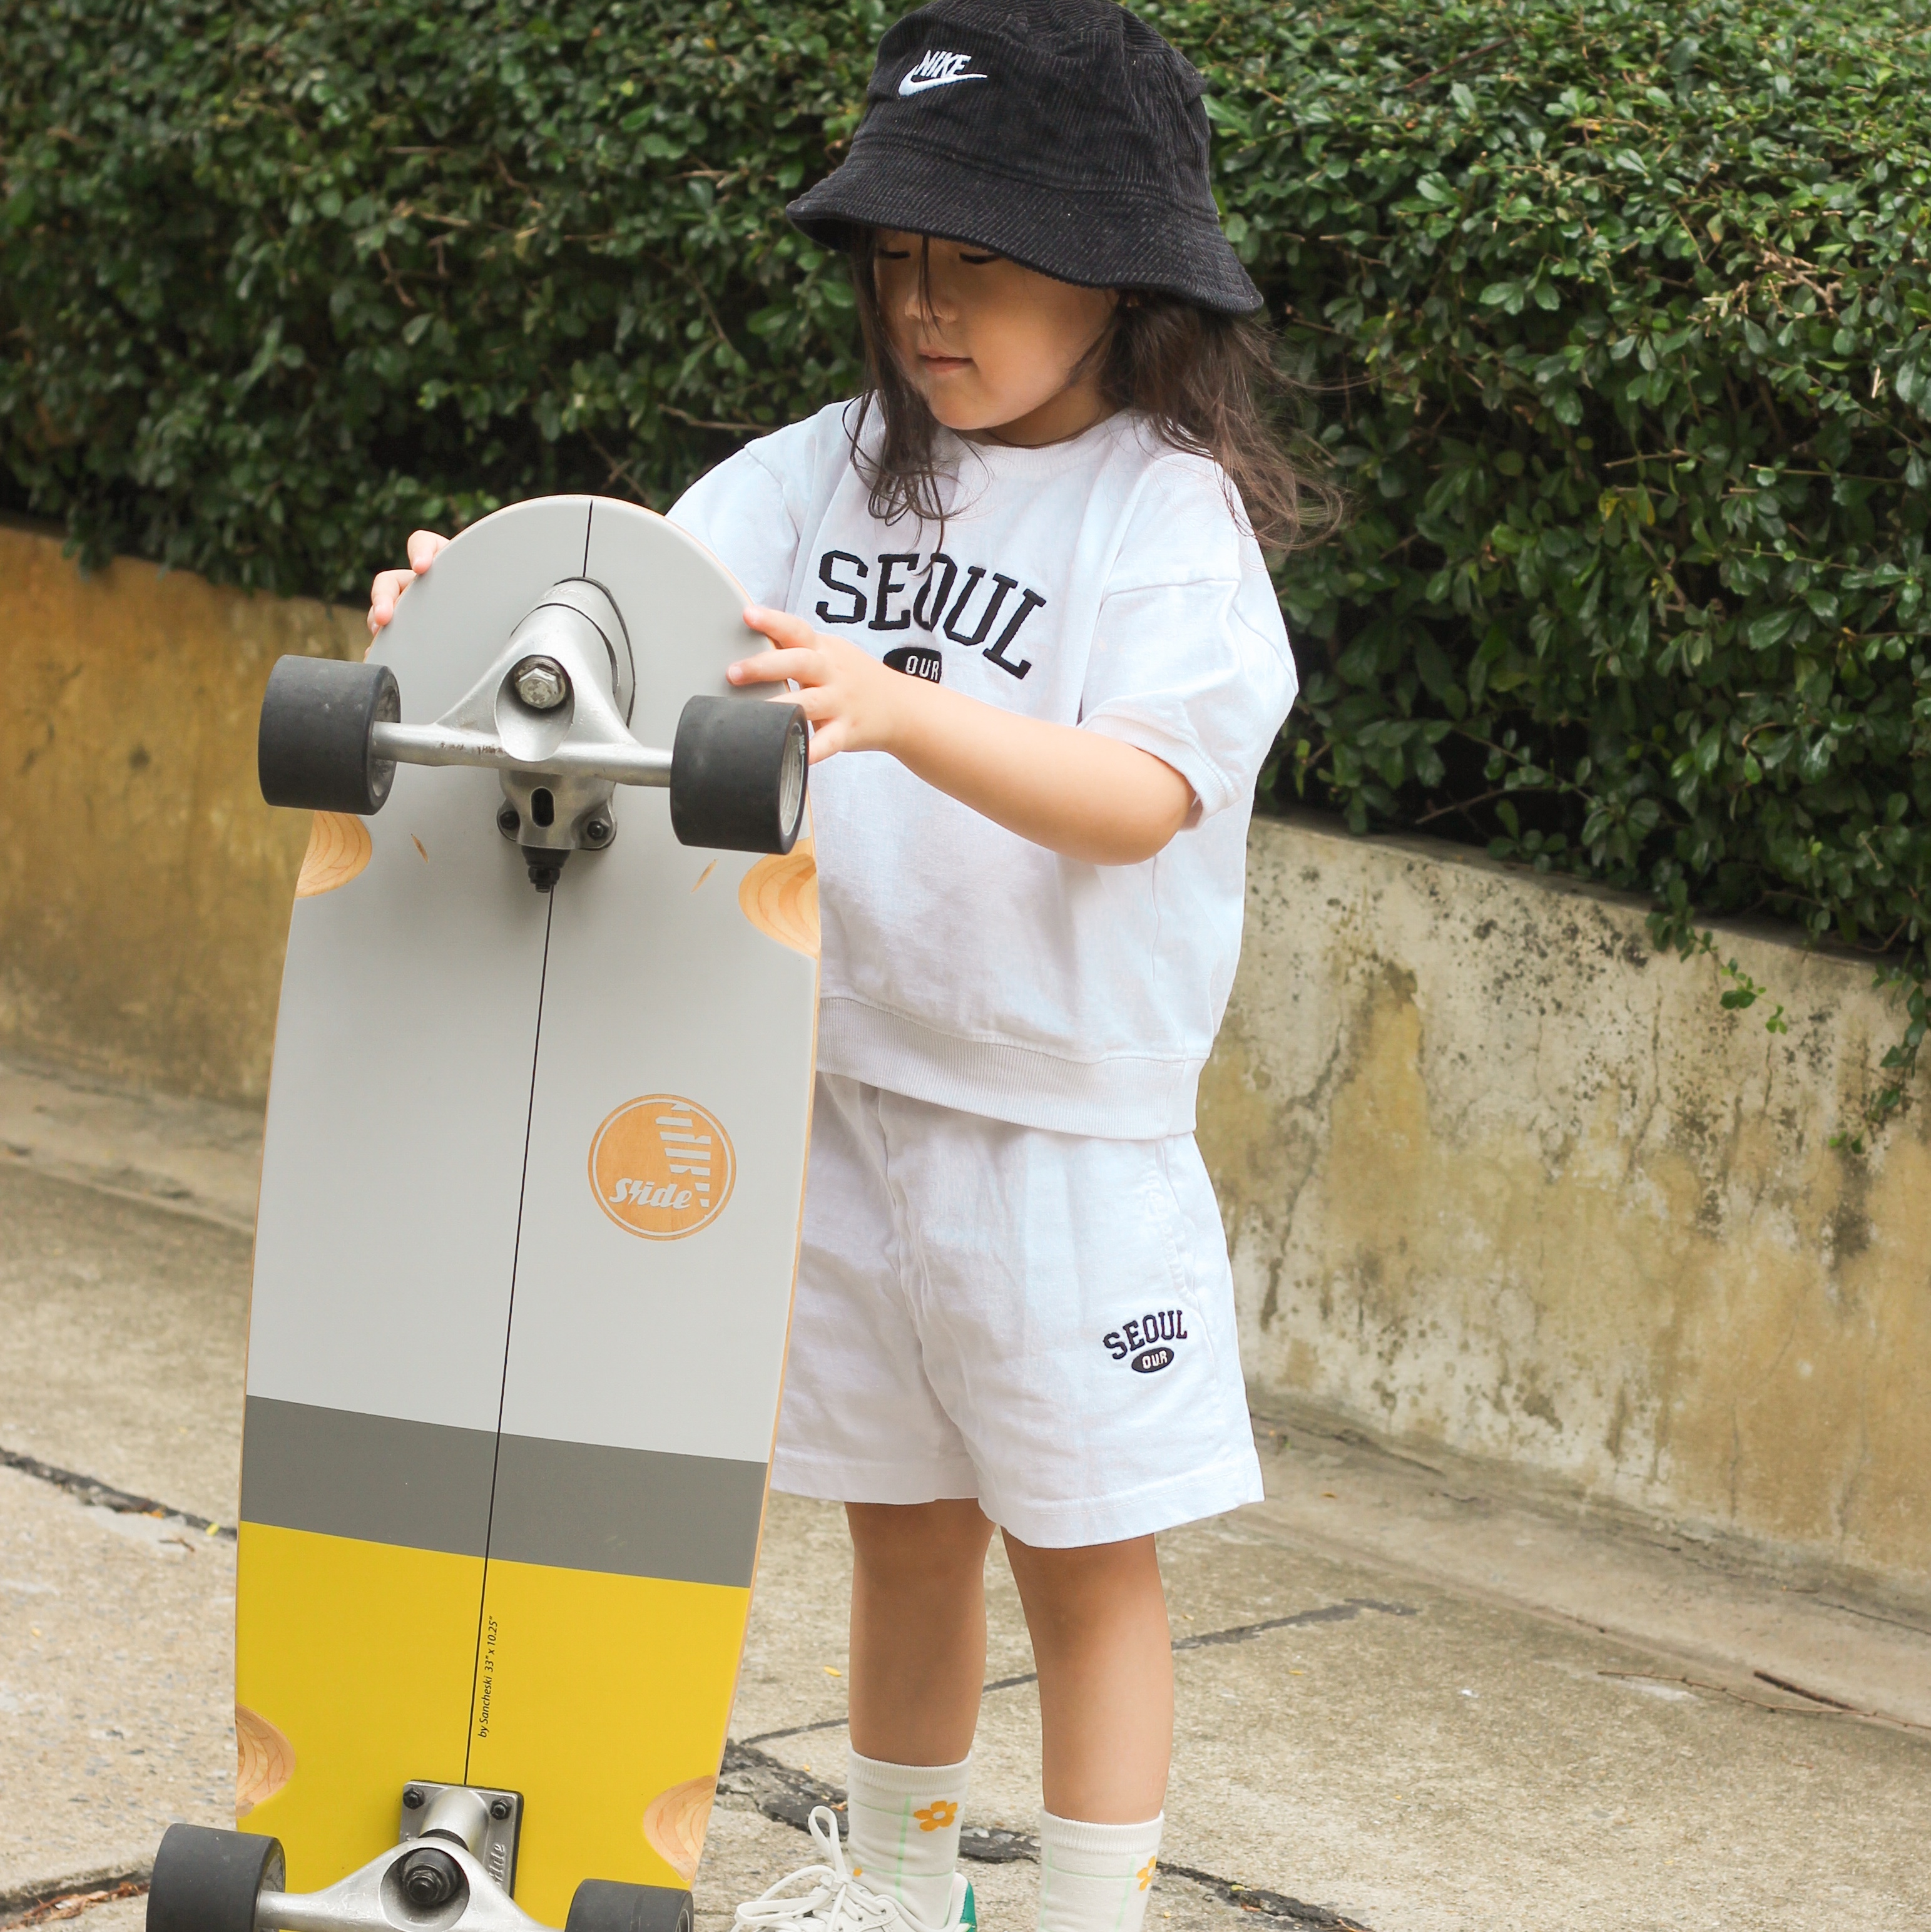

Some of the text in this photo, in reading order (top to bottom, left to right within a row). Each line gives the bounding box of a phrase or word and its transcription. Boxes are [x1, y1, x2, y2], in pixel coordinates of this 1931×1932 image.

[914, 49, 972, 78] NIKE
[815, 550, 1047, 680] SEOUL
[905, 655, 939, 681] OUR
[608, 1177, 693, 1210] Slide
[1103, 1309, 1188, 1360] SEOUL
[1141, 1350, 1168, 1369] OUR
[479, 1675, 492, 1724] Sancheski
[477, 1725, 489, 1738] by
